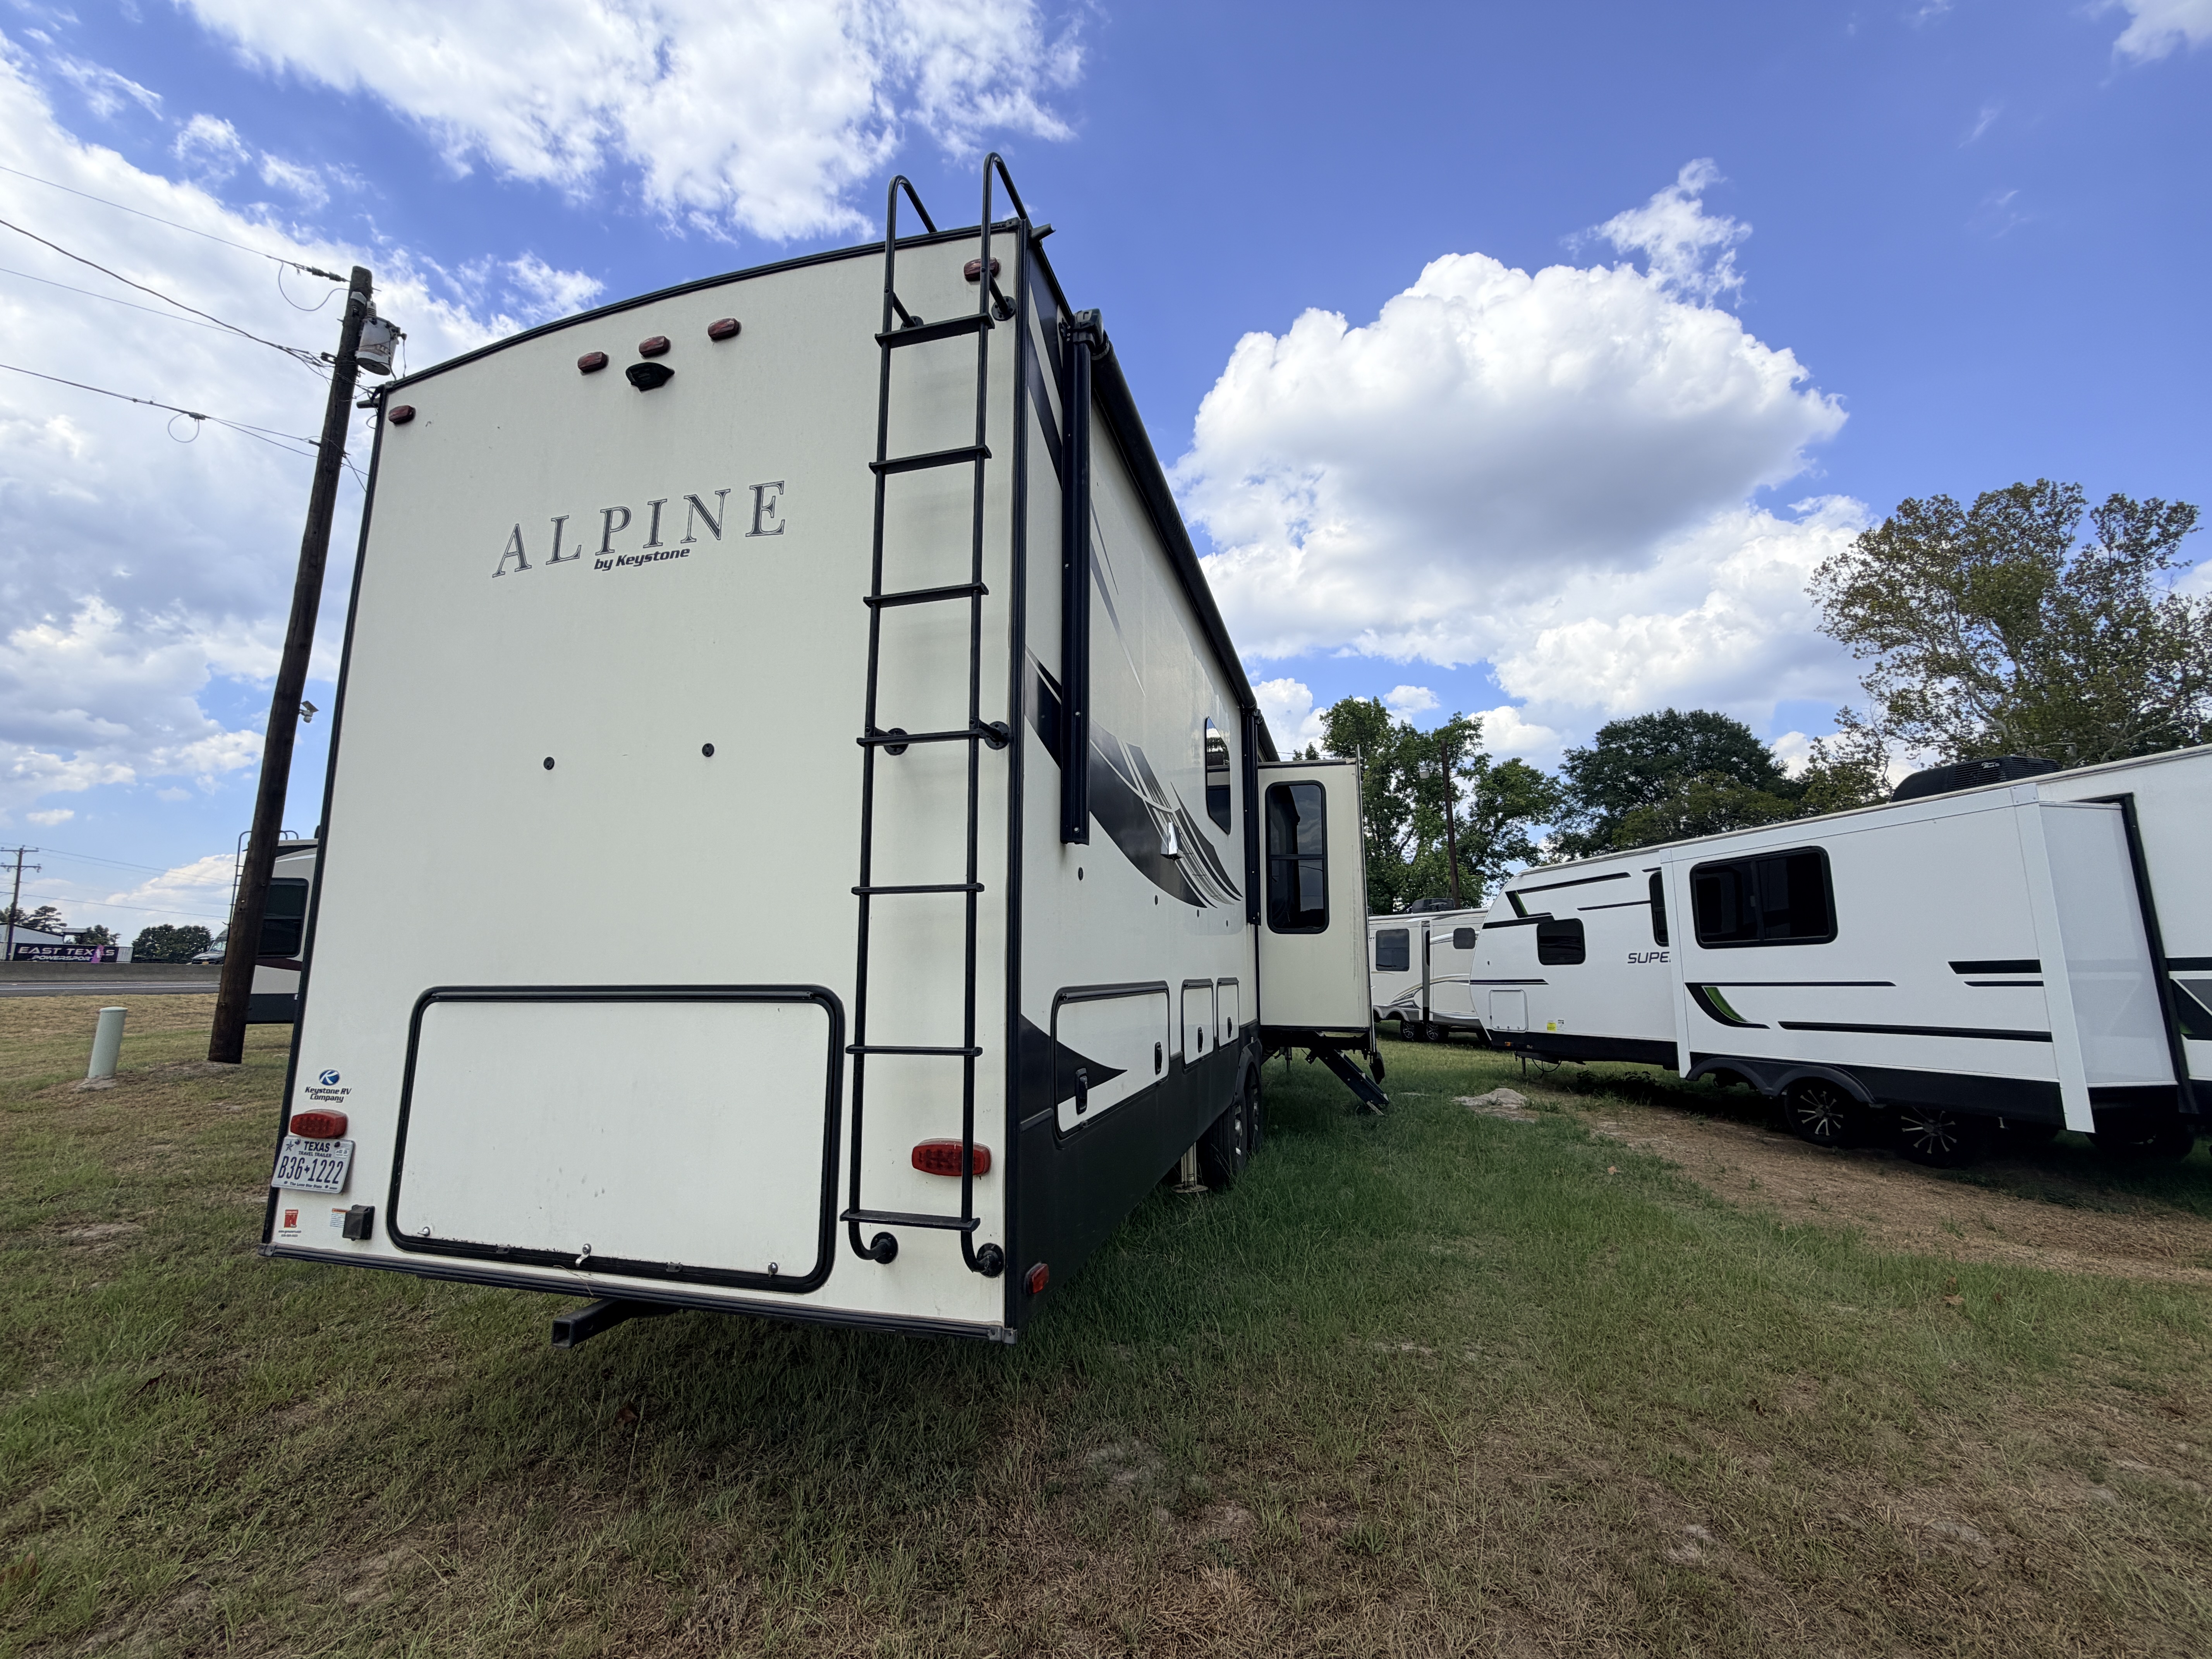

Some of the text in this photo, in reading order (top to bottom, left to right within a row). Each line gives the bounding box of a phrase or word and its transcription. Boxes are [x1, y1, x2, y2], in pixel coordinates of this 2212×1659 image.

[492, 481, 785, 578] ALPINE
[594, 549, 690, 571] by Keystone
[18, 946, 62, 955] EAST
[1627, 951, 1671, 963] SUPE
[305, 1086, 340, 1095] Keystone
[310, 1093, 344, 1103] Company
[304, 1141, 330, 1152] TEXAS
